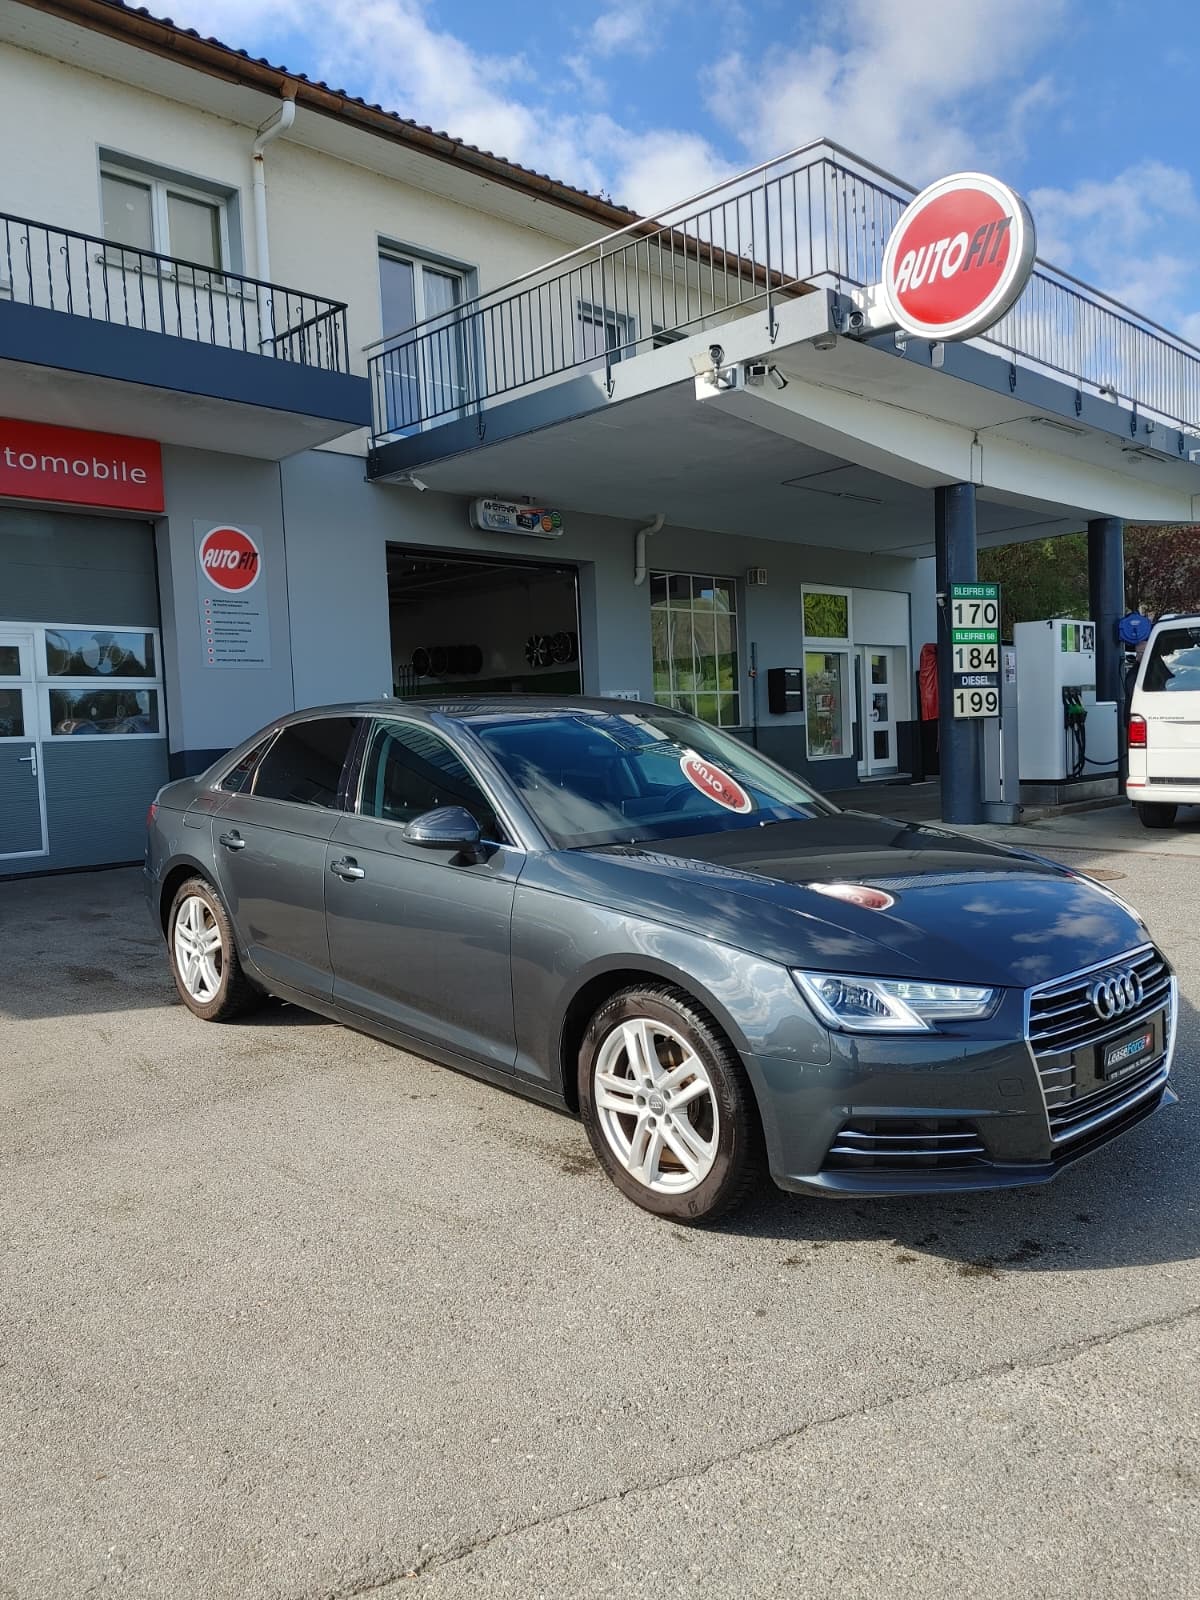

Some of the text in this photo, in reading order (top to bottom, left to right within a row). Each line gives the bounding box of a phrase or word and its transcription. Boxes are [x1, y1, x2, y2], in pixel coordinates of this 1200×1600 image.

[895, 216, 1013, 294] AUTOFIT
[4, 446, 147, 484] tomobile
[204, 548, 258, 571] AUTOFIT
[954, 587, 996, 596] BLEIFREI 95
[954, 603, 997, 625] 170
[955, 632, 986, 640] BLEIFREI
[955, 647, 997, 669] 184
[961, 675, 990, 686] DIESEL
[956, 691, 998, 713] 199
